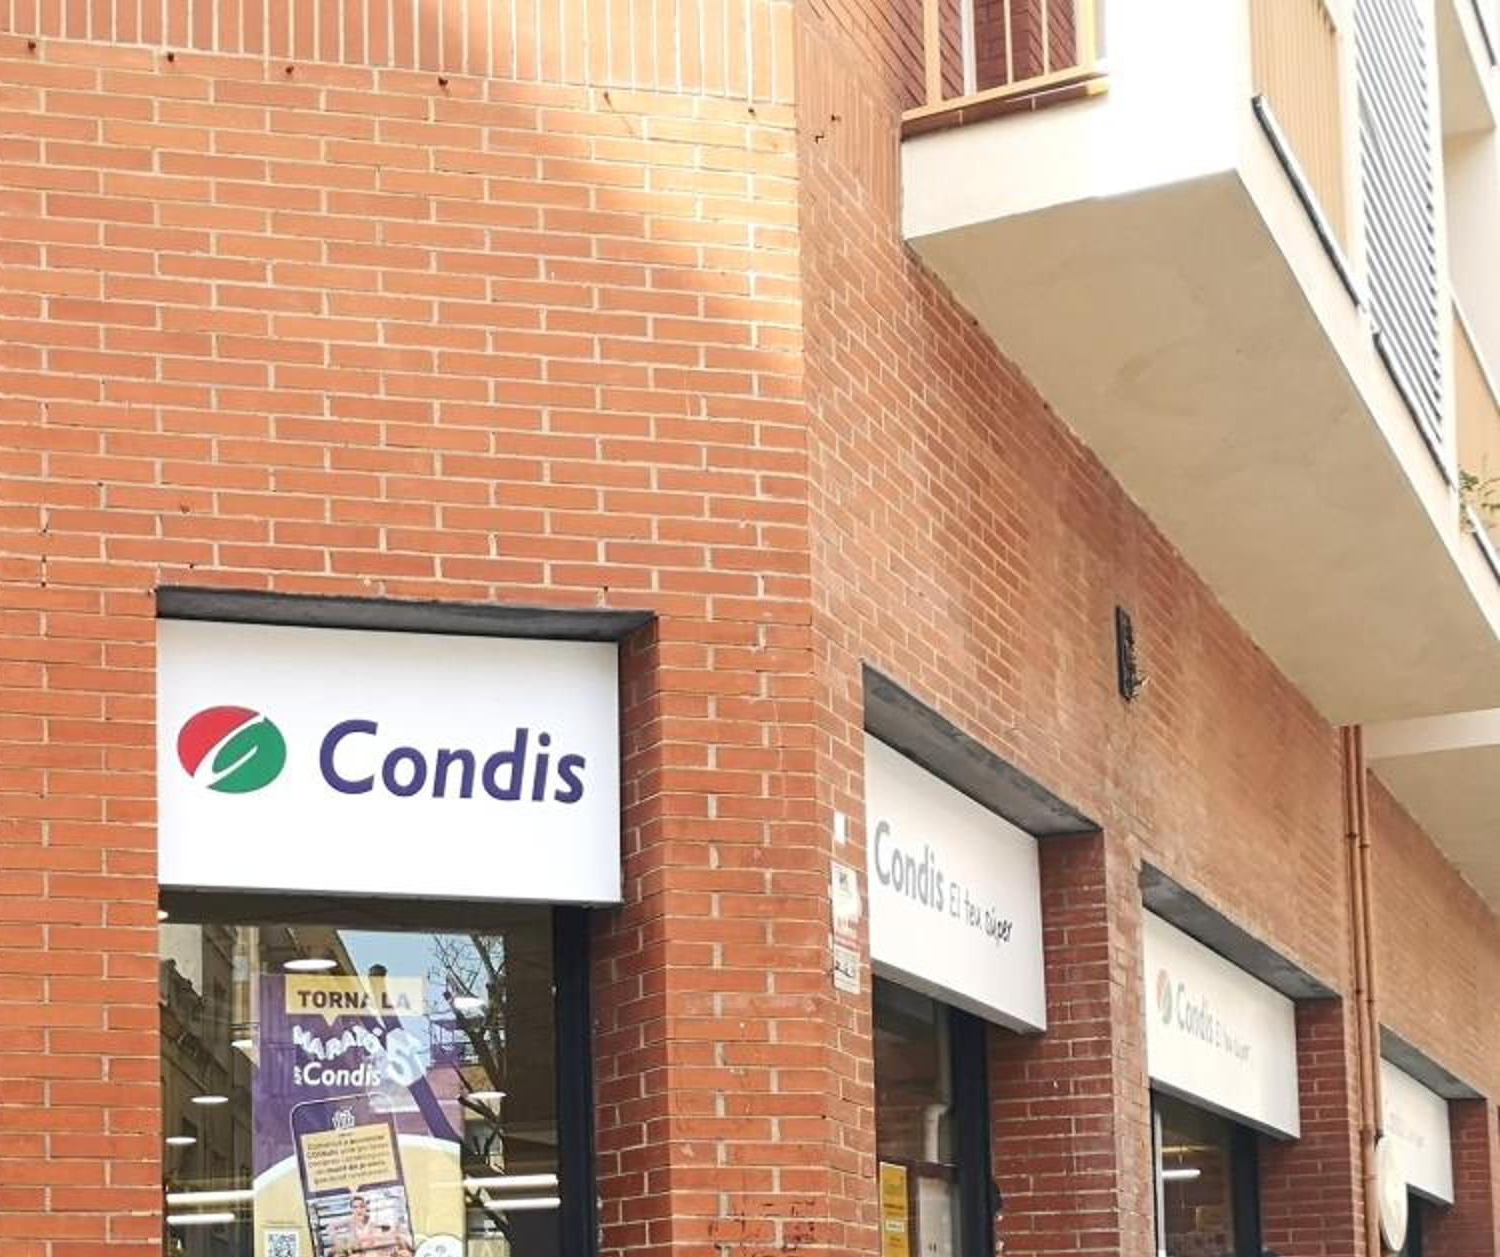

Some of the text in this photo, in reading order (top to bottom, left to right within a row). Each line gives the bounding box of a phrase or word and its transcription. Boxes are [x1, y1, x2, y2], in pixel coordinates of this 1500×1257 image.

[319, 719, 586, 804] Condis
[874, 820, 945, 913] Condis
[950, 881, 961, 919] El
[303, 1061, 381, 1087] Condis
